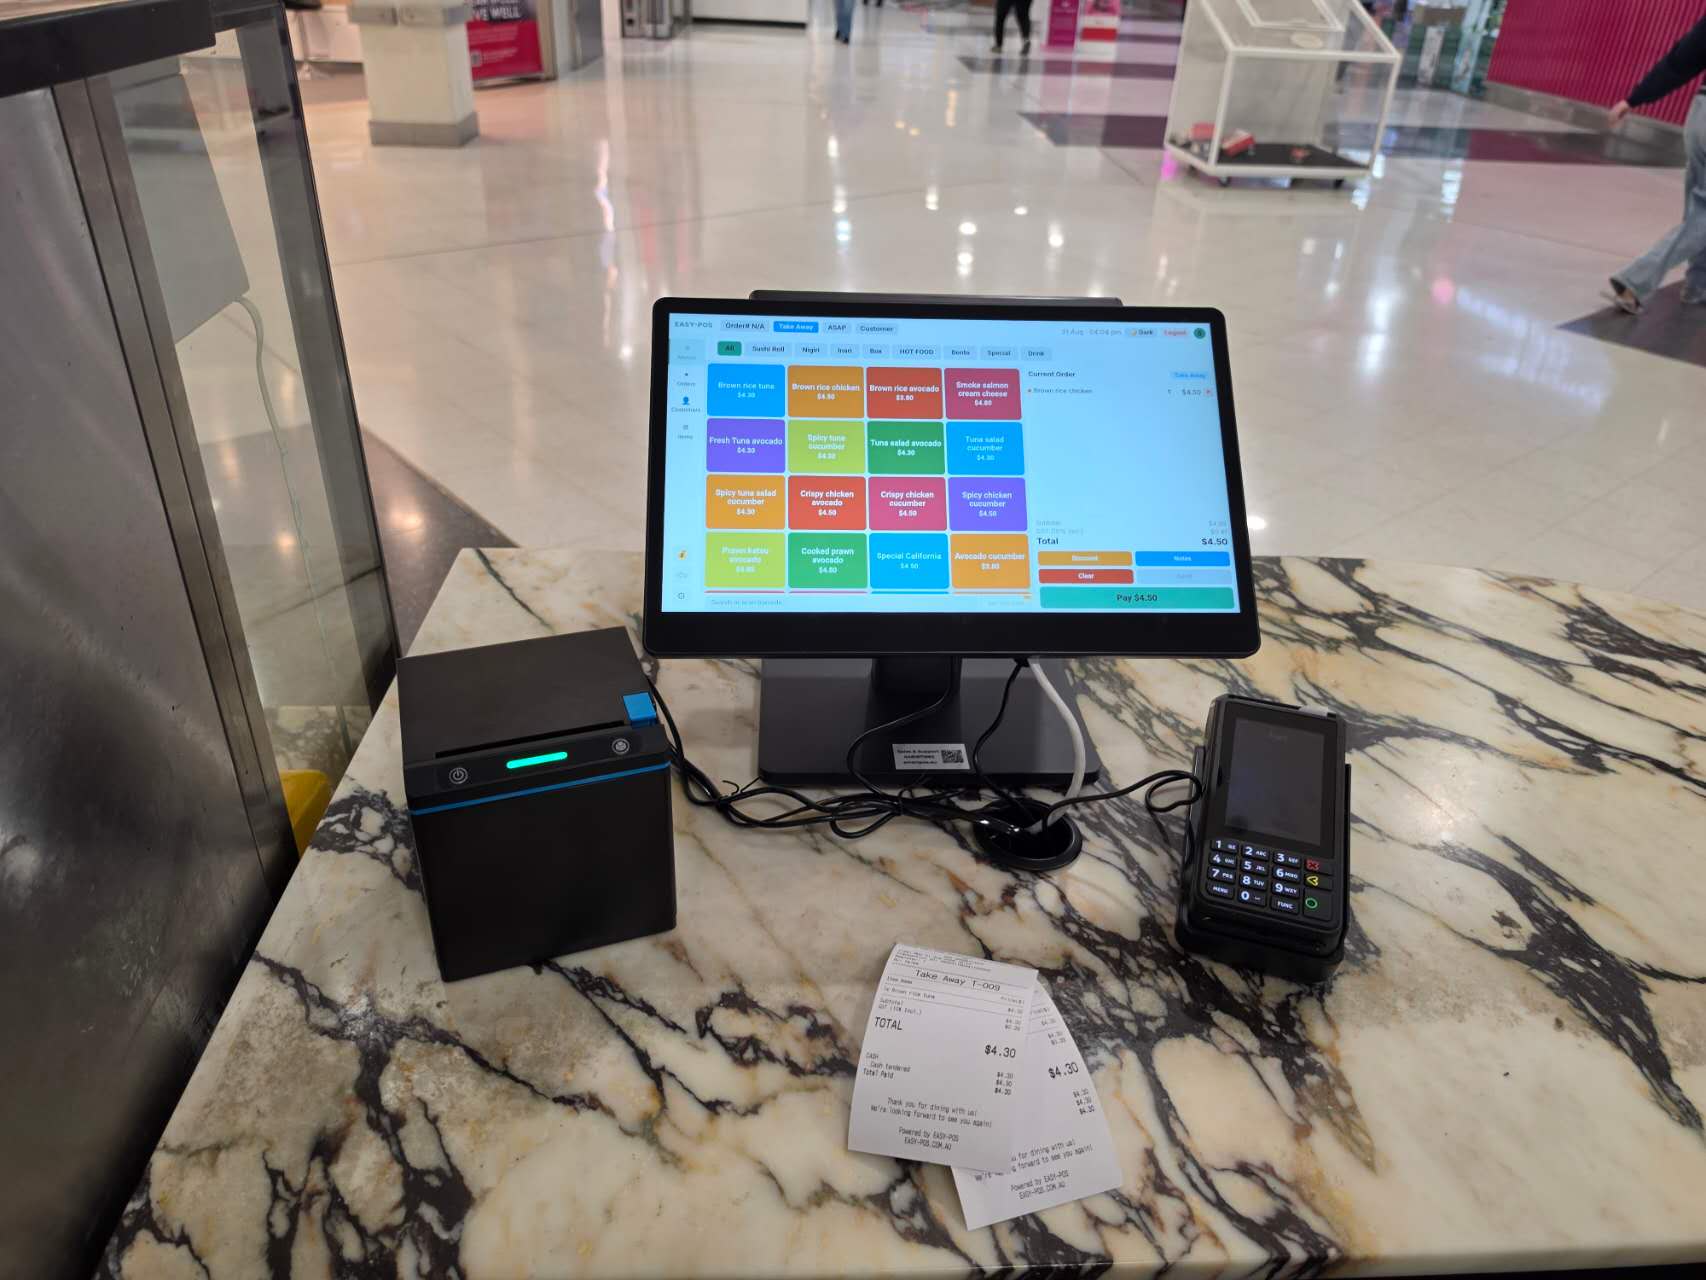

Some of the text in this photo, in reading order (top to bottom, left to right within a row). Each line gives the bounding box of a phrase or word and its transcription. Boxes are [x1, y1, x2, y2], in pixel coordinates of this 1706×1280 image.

[725, 322, 750, 330] Order#
[792, 383, 815, 391] Brown
[956, 381, 980, 389] Smoke
[982, 390, 1008, 398] cheese
[709, 437, 783, 446] Fresh Tuna avocado
[808, 434, 827, 443] Spicy
[985, 436, 1004, 444] salad
[870, 439, 942, 448] Tuna salad avocado
[715, 489, 736, 498] Spicy
[756, 489, 777, 497] salad
[800, 490, 854, 499] Crispy chicken
[880, 491, 934, 500] Crispy chicken
[962, 491, 982, 500] Spicy
[889, 499, 926, 507] cucumber
[969, 500, 1005, 508] cucumber
[1201, 538, 1228, 546] $4.50
[801, 548, 854, 557] Cooked prawn
[877, 553, 904, 561] Special
[1117, 594, 1157, 602] Pay $4.50
[1216, 840, 1222, 849] 1
[1245, 846, 1253, 856] 2
[1277, 853, 1285, 862] 3
[1213, 854, 1221, 863] 4
[1244, 861, 1252, 870] 5
[1276, 868, 1284, 877] 6
[1212, 869, 1220, 878] 7
[1242, 876, 1251, 885] 8
[1275, 883, 1283, 892] 9
[1213, 886, 1293, 909] MENU 0 FUNC
[916, 970, 938, 980] Take
[943, 976, 966, 986] Away
[874, 1016, 903, 1031] TOTAL
[866, 1052, 879, 1060] CASH
[984, 1045, 1016, 1058] $4.30
[863, 1067, 894, 1079] Total Paid
[1048, 1062, 1079, 1079] $4.30
[887, 1096, 965, 1115] Thank you for dining with
[890, 1106, 911, 1117] looking
[914, 1109, 936, 1120] forward
[898, 1126, 959, 1142] Powered by EASY-POS
[904, 1137, 952, 1151] EASY-POS.COM.AU
[1018, 1150, 1028, 1160] for
[1031, 1146, 1050, 1157] dining
[1051, 1142, 1065, 1151] with
[1018, 1157, 1041, 1170] forward
[1042, 1155, 1049, 1164] to
[1010, 1169, 1069, 1192] Powered by EASY-POS
